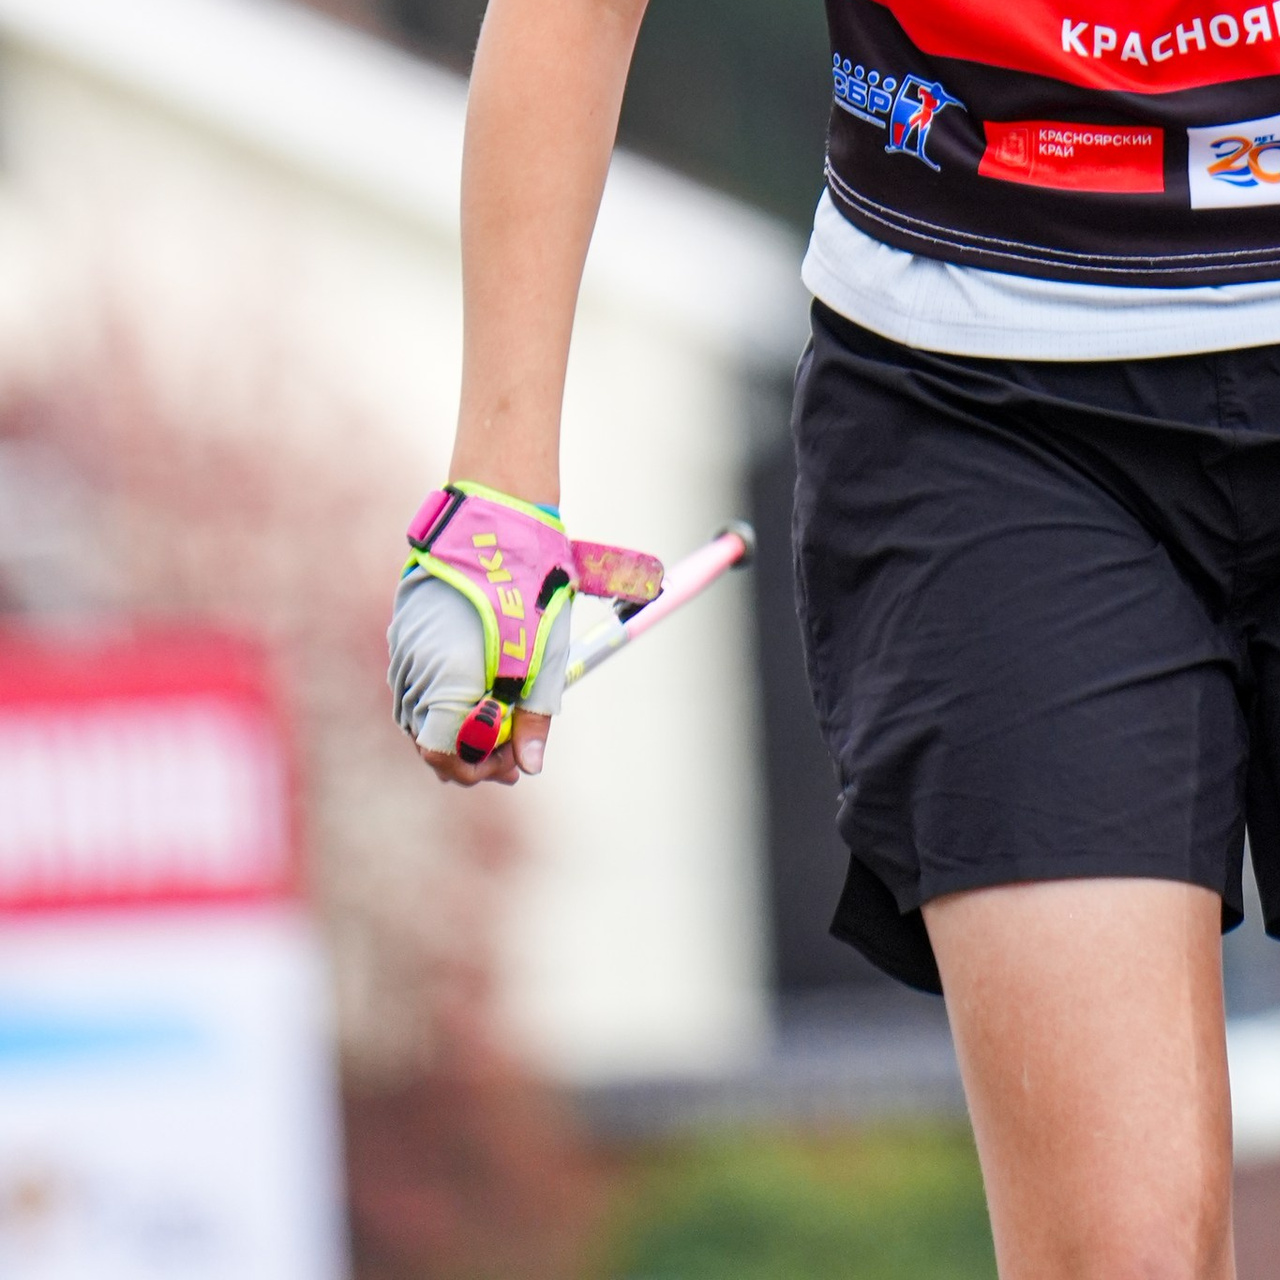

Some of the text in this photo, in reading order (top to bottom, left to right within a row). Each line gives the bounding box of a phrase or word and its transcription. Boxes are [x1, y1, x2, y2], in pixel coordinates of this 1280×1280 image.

[832, 66, 893, 114] СБР
[1038, 142, 1075, 158] КРАЙ
[471, 532, 527, 662] LEKI
